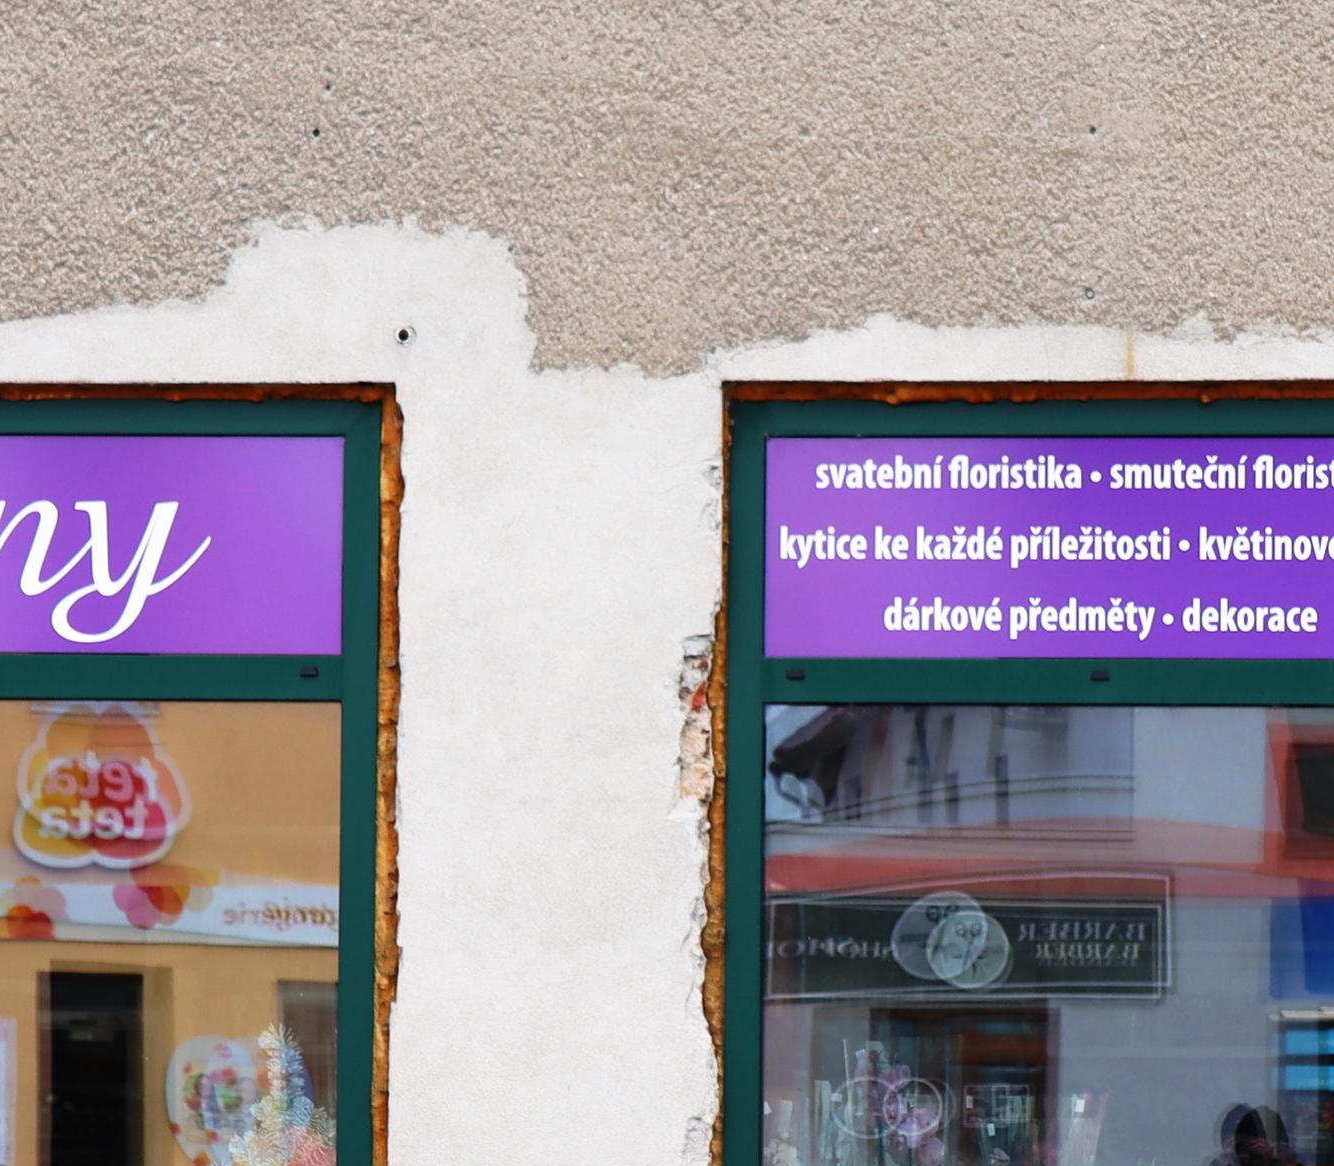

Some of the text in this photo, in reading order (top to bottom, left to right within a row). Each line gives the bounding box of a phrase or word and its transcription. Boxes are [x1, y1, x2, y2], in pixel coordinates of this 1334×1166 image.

[815, 455, 942, 490] svatební
[948, 454, 1082, 490] floristika
[1109, 455, 1247, 490] smuteční
[779, 525, 867, 569] kytice
[874, 525, 909, 561] ke
[916, 525, 1004, 561] každé
[1010, 525, 1171, 569] příležitosti
[883, 597, 1318, 640] dárkové předměty dekorace
